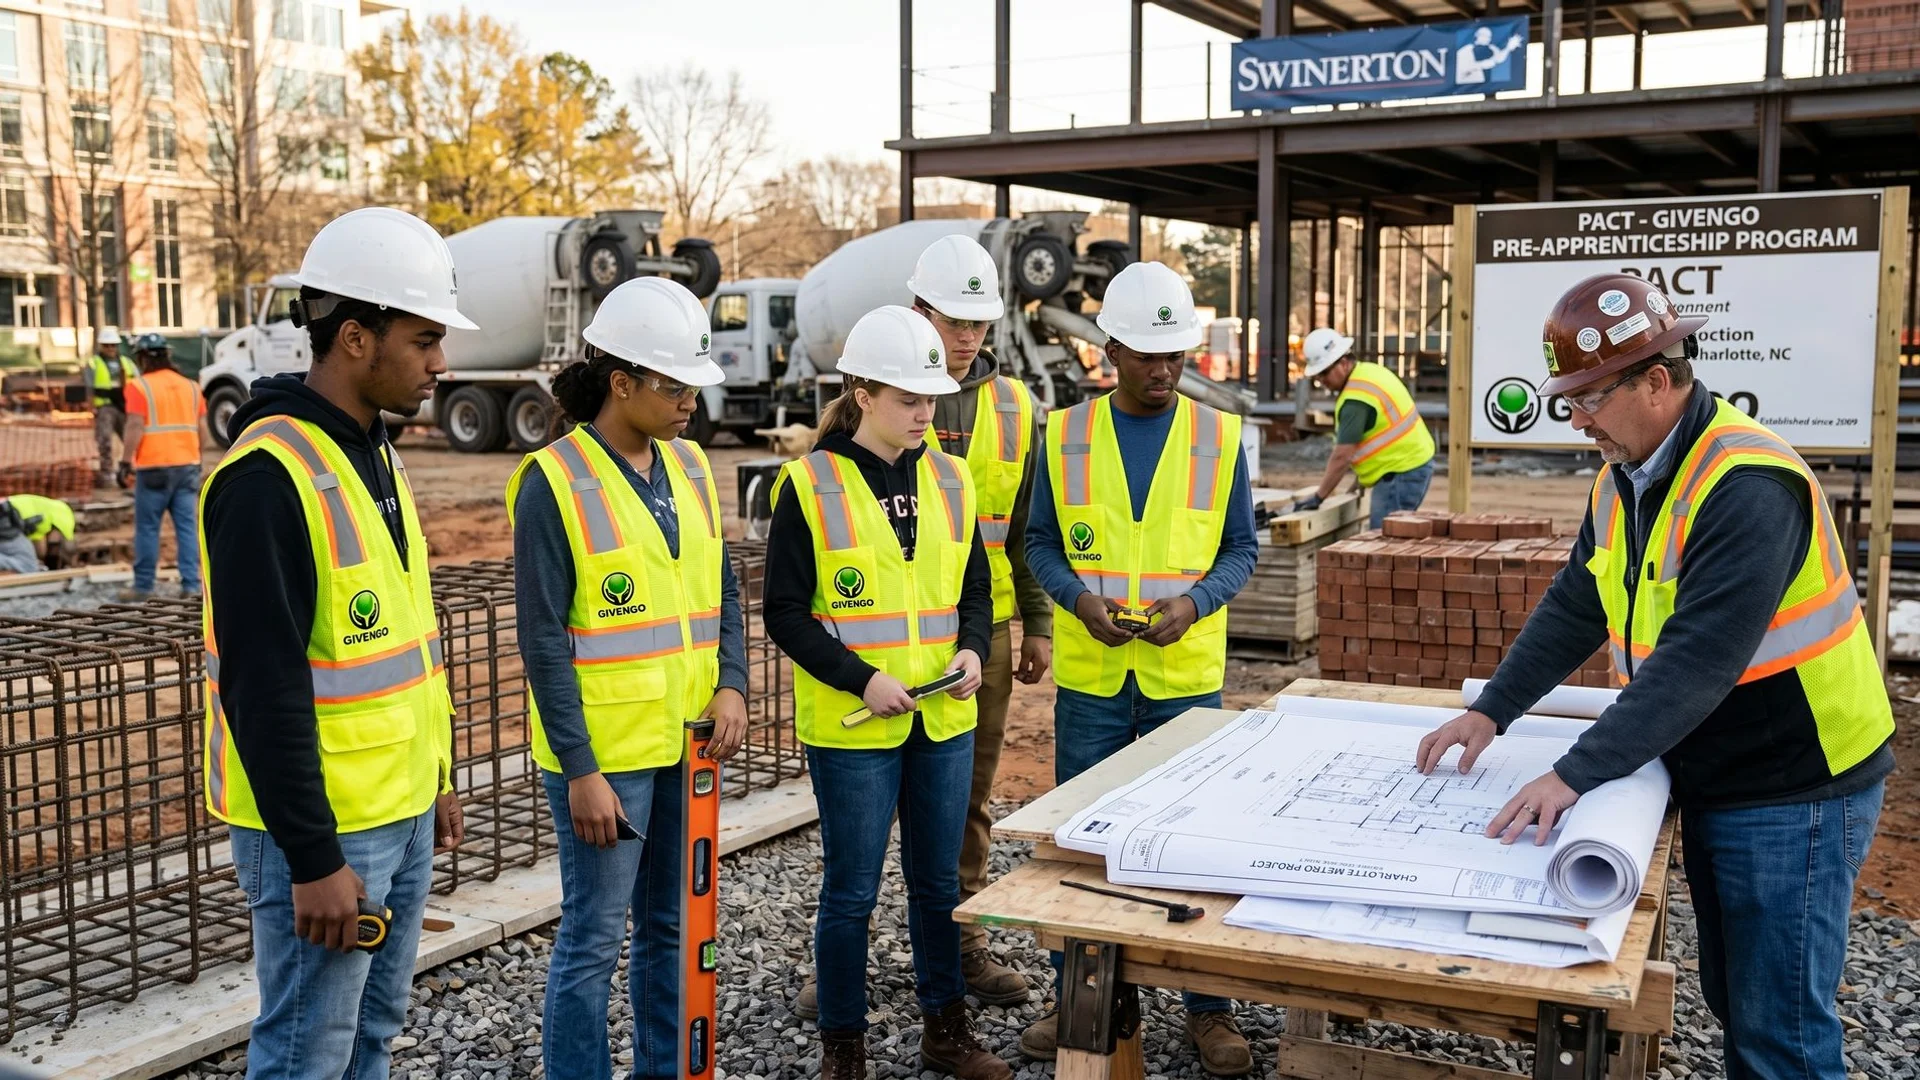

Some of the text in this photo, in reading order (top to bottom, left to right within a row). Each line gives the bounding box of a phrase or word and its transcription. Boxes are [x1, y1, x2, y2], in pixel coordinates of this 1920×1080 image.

[1238, 48, 1448, 92] SWINERTON
[1578, 211, 1635, 231] PACT
[1652, 206, 1760, 229] GIVENGO
[1493, 227, 1858, 257] PRE-APPRENTICESHIP PROGRAM
[1697, 327, 1754, 341] oction
[1694, 347, 1791, 362] harlotte, NC
[598, 604, 646, 618] GIVENGO
[831, 599, 874, 609] GIVENGO
[343, 627, 389, 645] GIVENGO
[1249, 859, 1301, 871] PROJECT
[1304, 865, 1346, 875] METRO
[1348, 868, 1418, 883] CHARLOTTE
